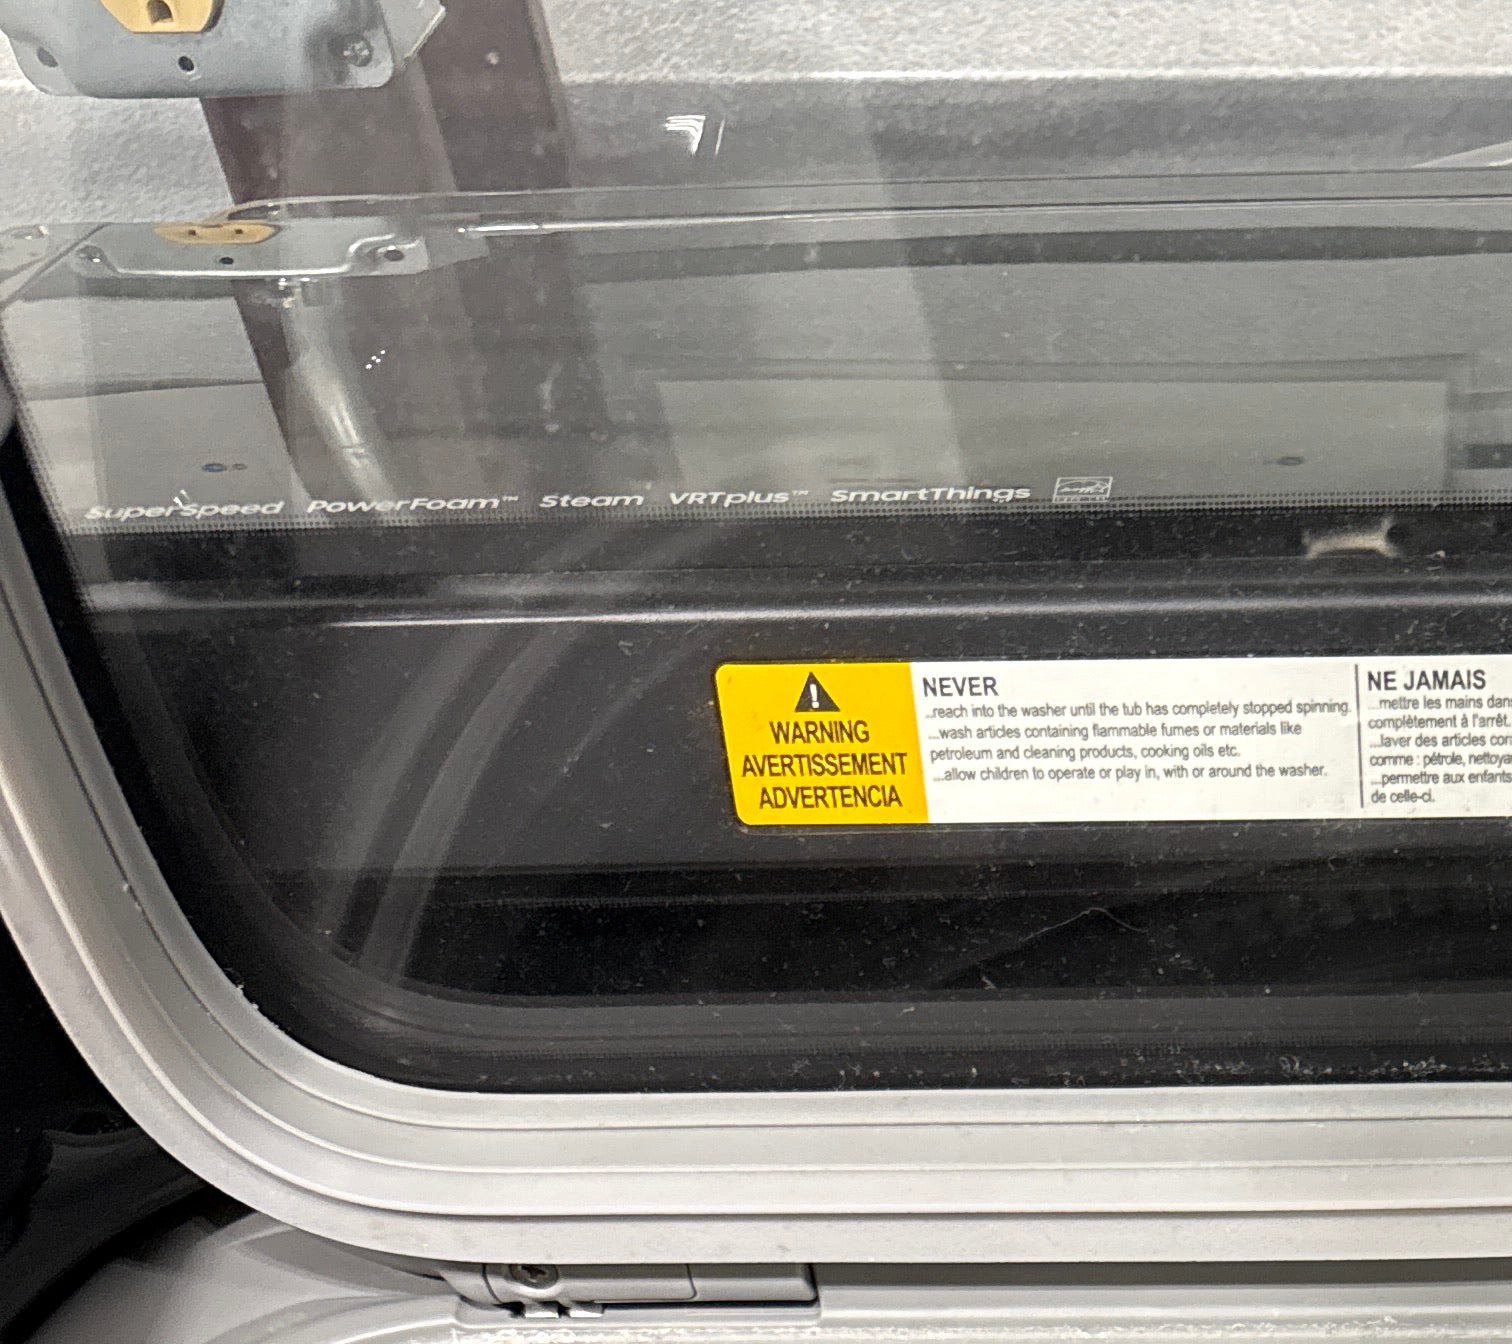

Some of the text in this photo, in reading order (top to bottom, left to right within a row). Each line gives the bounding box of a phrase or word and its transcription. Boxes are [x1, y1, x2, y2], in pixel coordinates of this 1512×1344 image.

[84, 500, 285, 522] SuperSpeed
[539, 494, 644, 508] Steam
[831, 486, 1031, 503] SmartThings
[922, 675, 999, 697] NEVER
[1366, 668, 1486, 691] NE JAMAIS
[971, 703, 994, 718] into
[996, 703, 1018, 718] the
[1020, 702, 1067, 717] washer
[1069, 702, 1096, 717] until
[1098, 701, 1119, 716] the
[1121, 701, 1142, 716] tub
[1144, 701, 1169, 716] has
[1171, 700, 1239, 718] completely
[1242, 698, 1293, 717] stopped
[1295, 698, 1351, 717] spinning.
[1422, 694, 1442, 710] les
[1444, 694, 1483, 709] mains
[768, 719, 870, 744] WARNING
[975, 724, 1021, 739] articles
[1023, 723, 1089, 741] containing
[1091, 722, 1157, 738] flammable
[1160, 721, 1200, 737] fumes
[1202, 724, 1216, 736] or
[1219, 720, 1277, 736] materials
[1279, 720, 1302, 735] like
[1367, 713, 1457, 732] complètement
[1460, 712, 1469, 728] à
[1414, 732, 1438, 748] des
[1440, 731, 1486, 747] articles
[929, 742, 1240, 764] petroleum and cleaning products, cooking oils etc.
[1369, 754, 1414, 767] comme
[1422, 751, 1466, 769] pétrole,
[741, 751, 908, 777] AVERTISSEMENT
[979, 766, 1029, 781] children
[1031, 766, 1045, 780] to
[1047, 765, 1095, 783] operate
[1098, 767, 1112, 779] or
[1114, 764, 1141, 783] play
[1144, 764, 1160, 780] in,
[1162, 764, 1189, 779] with
[1191, 766, 1205, 778] or
[1208, 762, 1252, 778] around
[1254, 763, 1275, 778] the
[1278, 762, 1327, 777] washer.
[1442, 772, 1465, 784] aux
[1467, 768, 1512, 784] enfants
[758, 783, 903, 809] ADVERTENCIA
[1370, 788, 1387, 804] de
